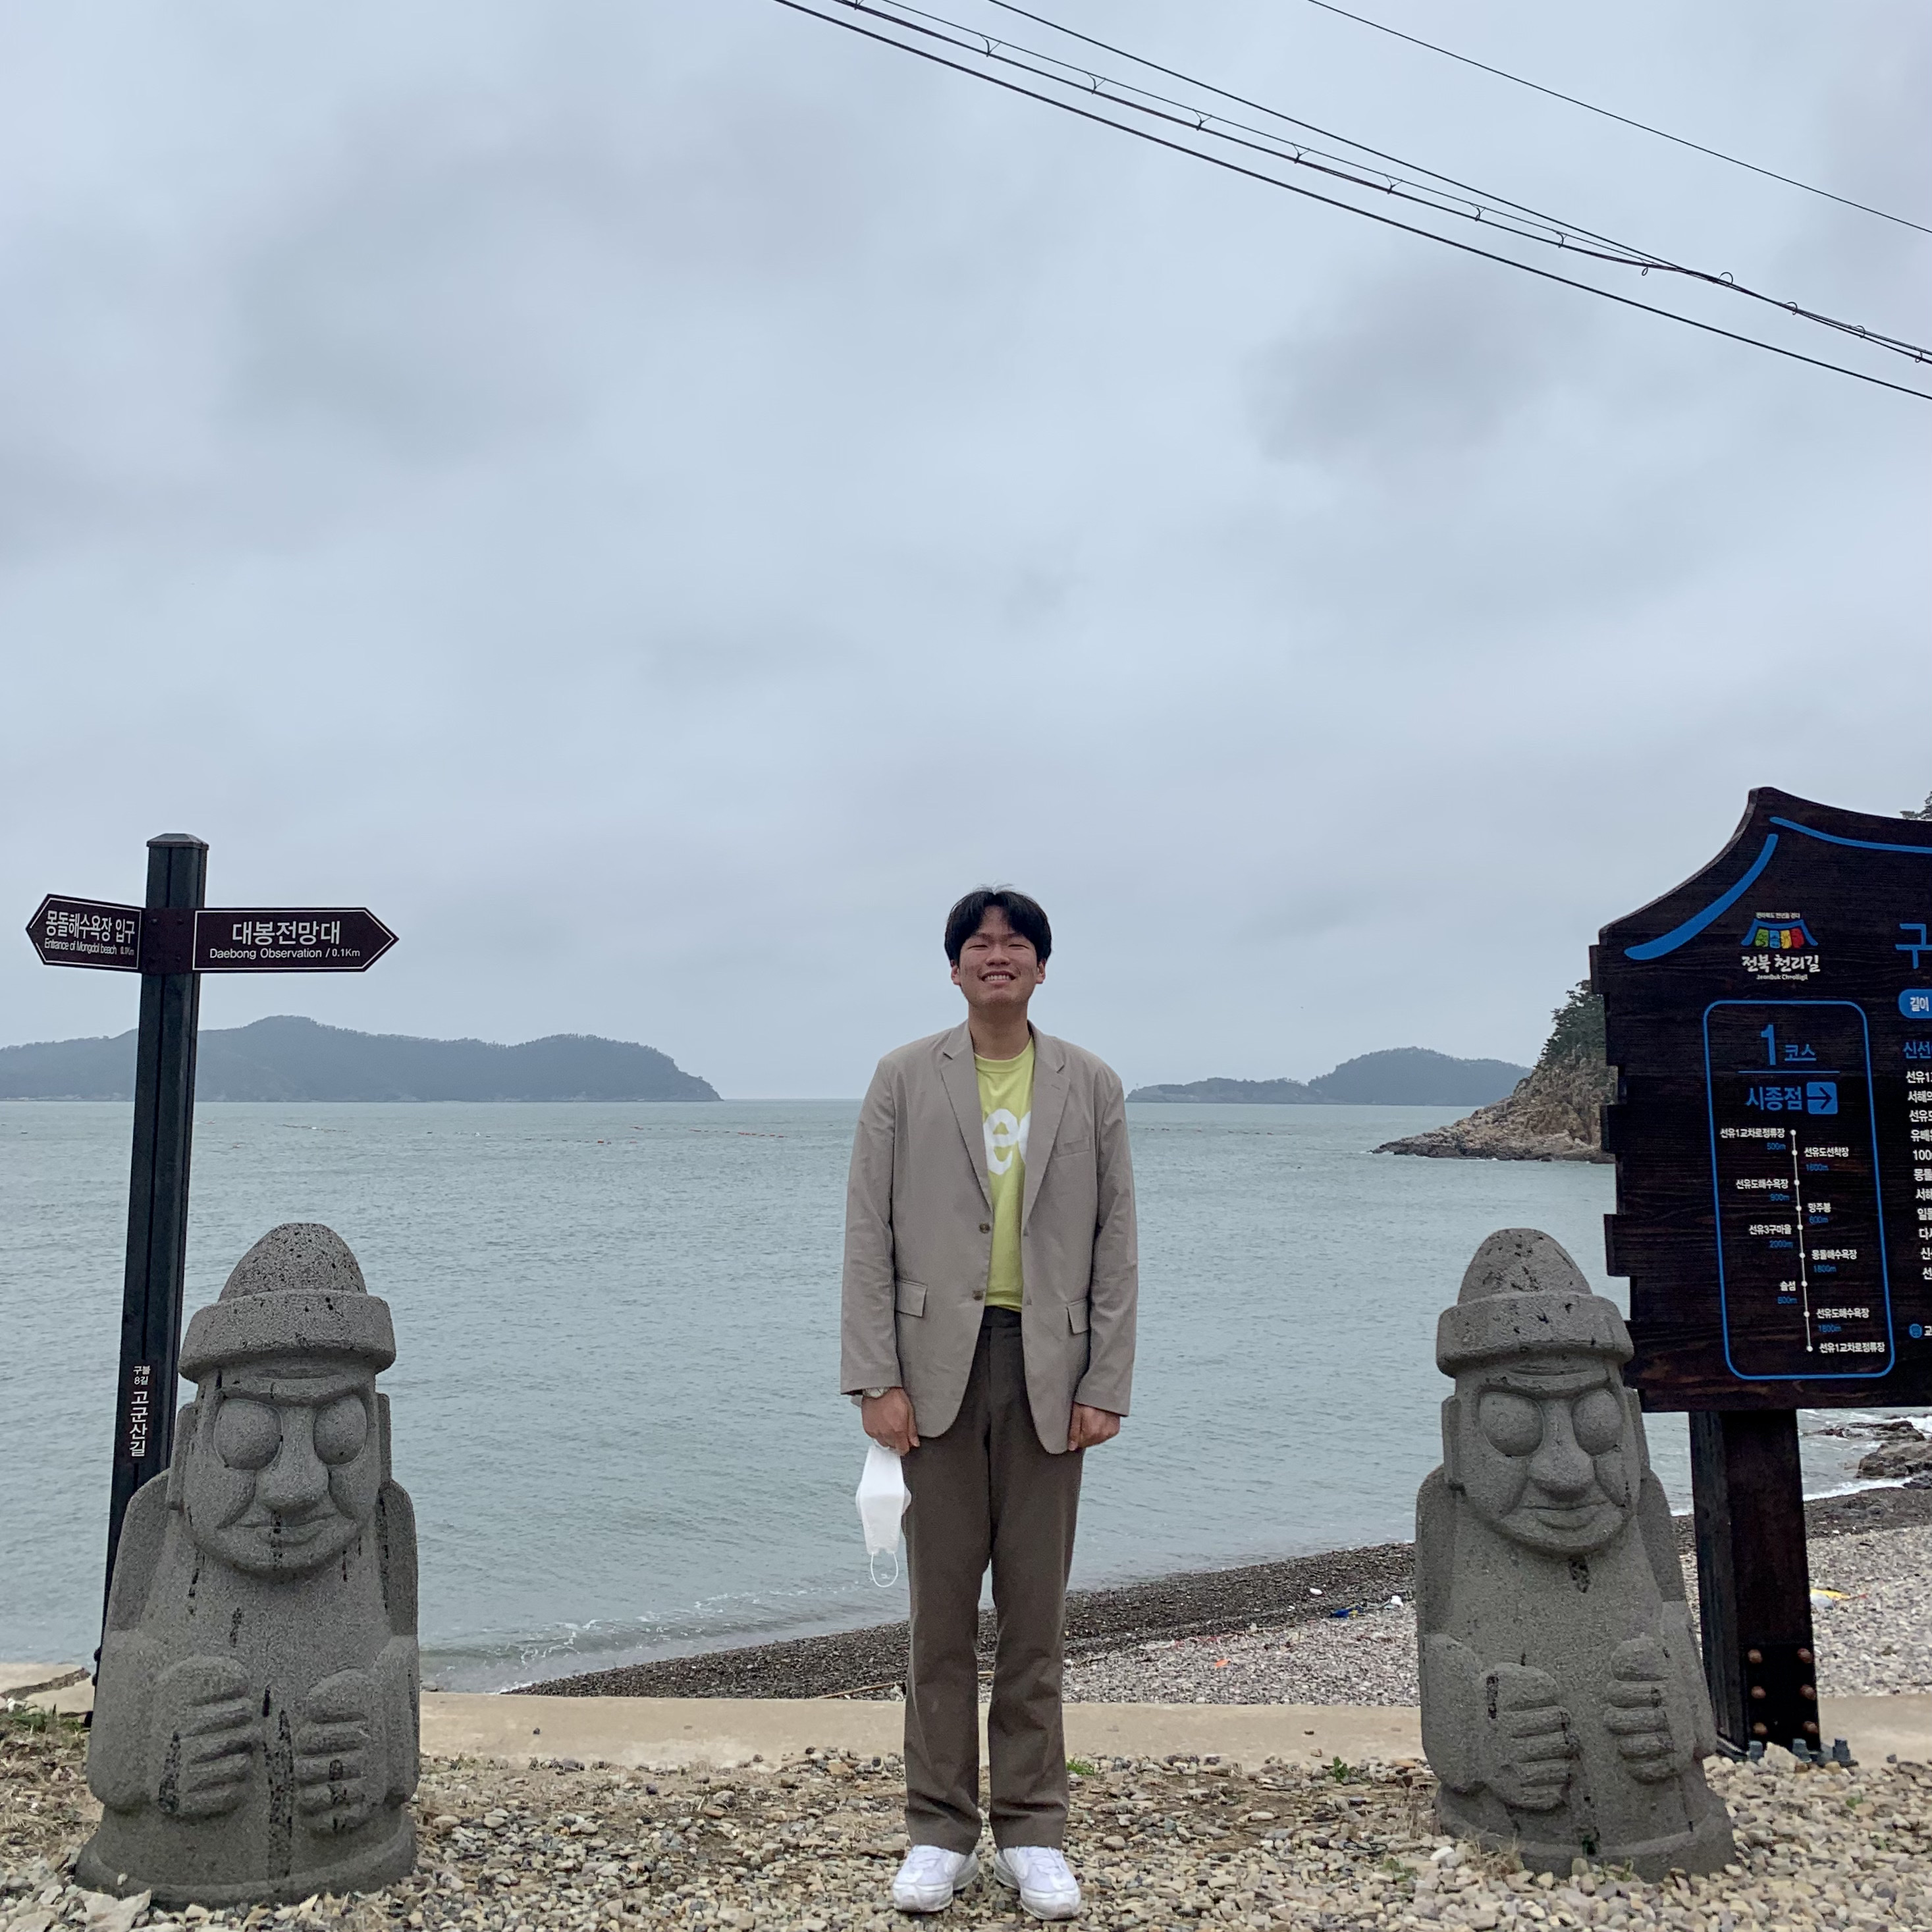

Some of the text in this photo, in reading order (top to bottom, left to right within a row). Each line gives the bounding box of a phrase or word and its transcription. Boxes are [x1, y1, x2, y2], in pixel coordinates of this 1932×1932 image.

[45, 910, 135, 944] 몽돌해수욕장 입구
[232, 921, 340, 945] 대봉전망대
[45, 938, 70, 951] Entrance
[76, 942, 100, 954] Mongdol
[100, 944, 117, 955] beach
[209, 948, 256, 959] Daebong
[260, 948, 322, 958] Observation
[1742, 954, 1821, 973] 전북 천리길
[1910, 996, 1929, 1011] 길이
[1760, 1024, 1817, 1065] 1 코스
[1903, 1041, 1932, 1059] 신선
[1906, 1071, 1932, 1084] 선유1
[1746, 1087, 1802, 1111] 시종점
[1719, 1128, 1785, 1139] 선유1교차로정류장
[1910, 1129, 1932, 1142] 유배
[1804, 1146, 1849, 1157] 선유도선착장
[1913, 1150, 1932, 1160] 100
[1808, 1202, 1831, 1213] 망주봉
[1749, 1224, 1792, 1235] 선유3구마을
[1919, 1227, 1932, 1240] 다
[1816, 1308, 1869, 1319] 선유도해수욕장
[1819, 1342, 1885, 1353] 선유1교차로정류장
[134, 1376, 148, 1385] 8길
[129, 1391, 149, 1457] 고군산길
